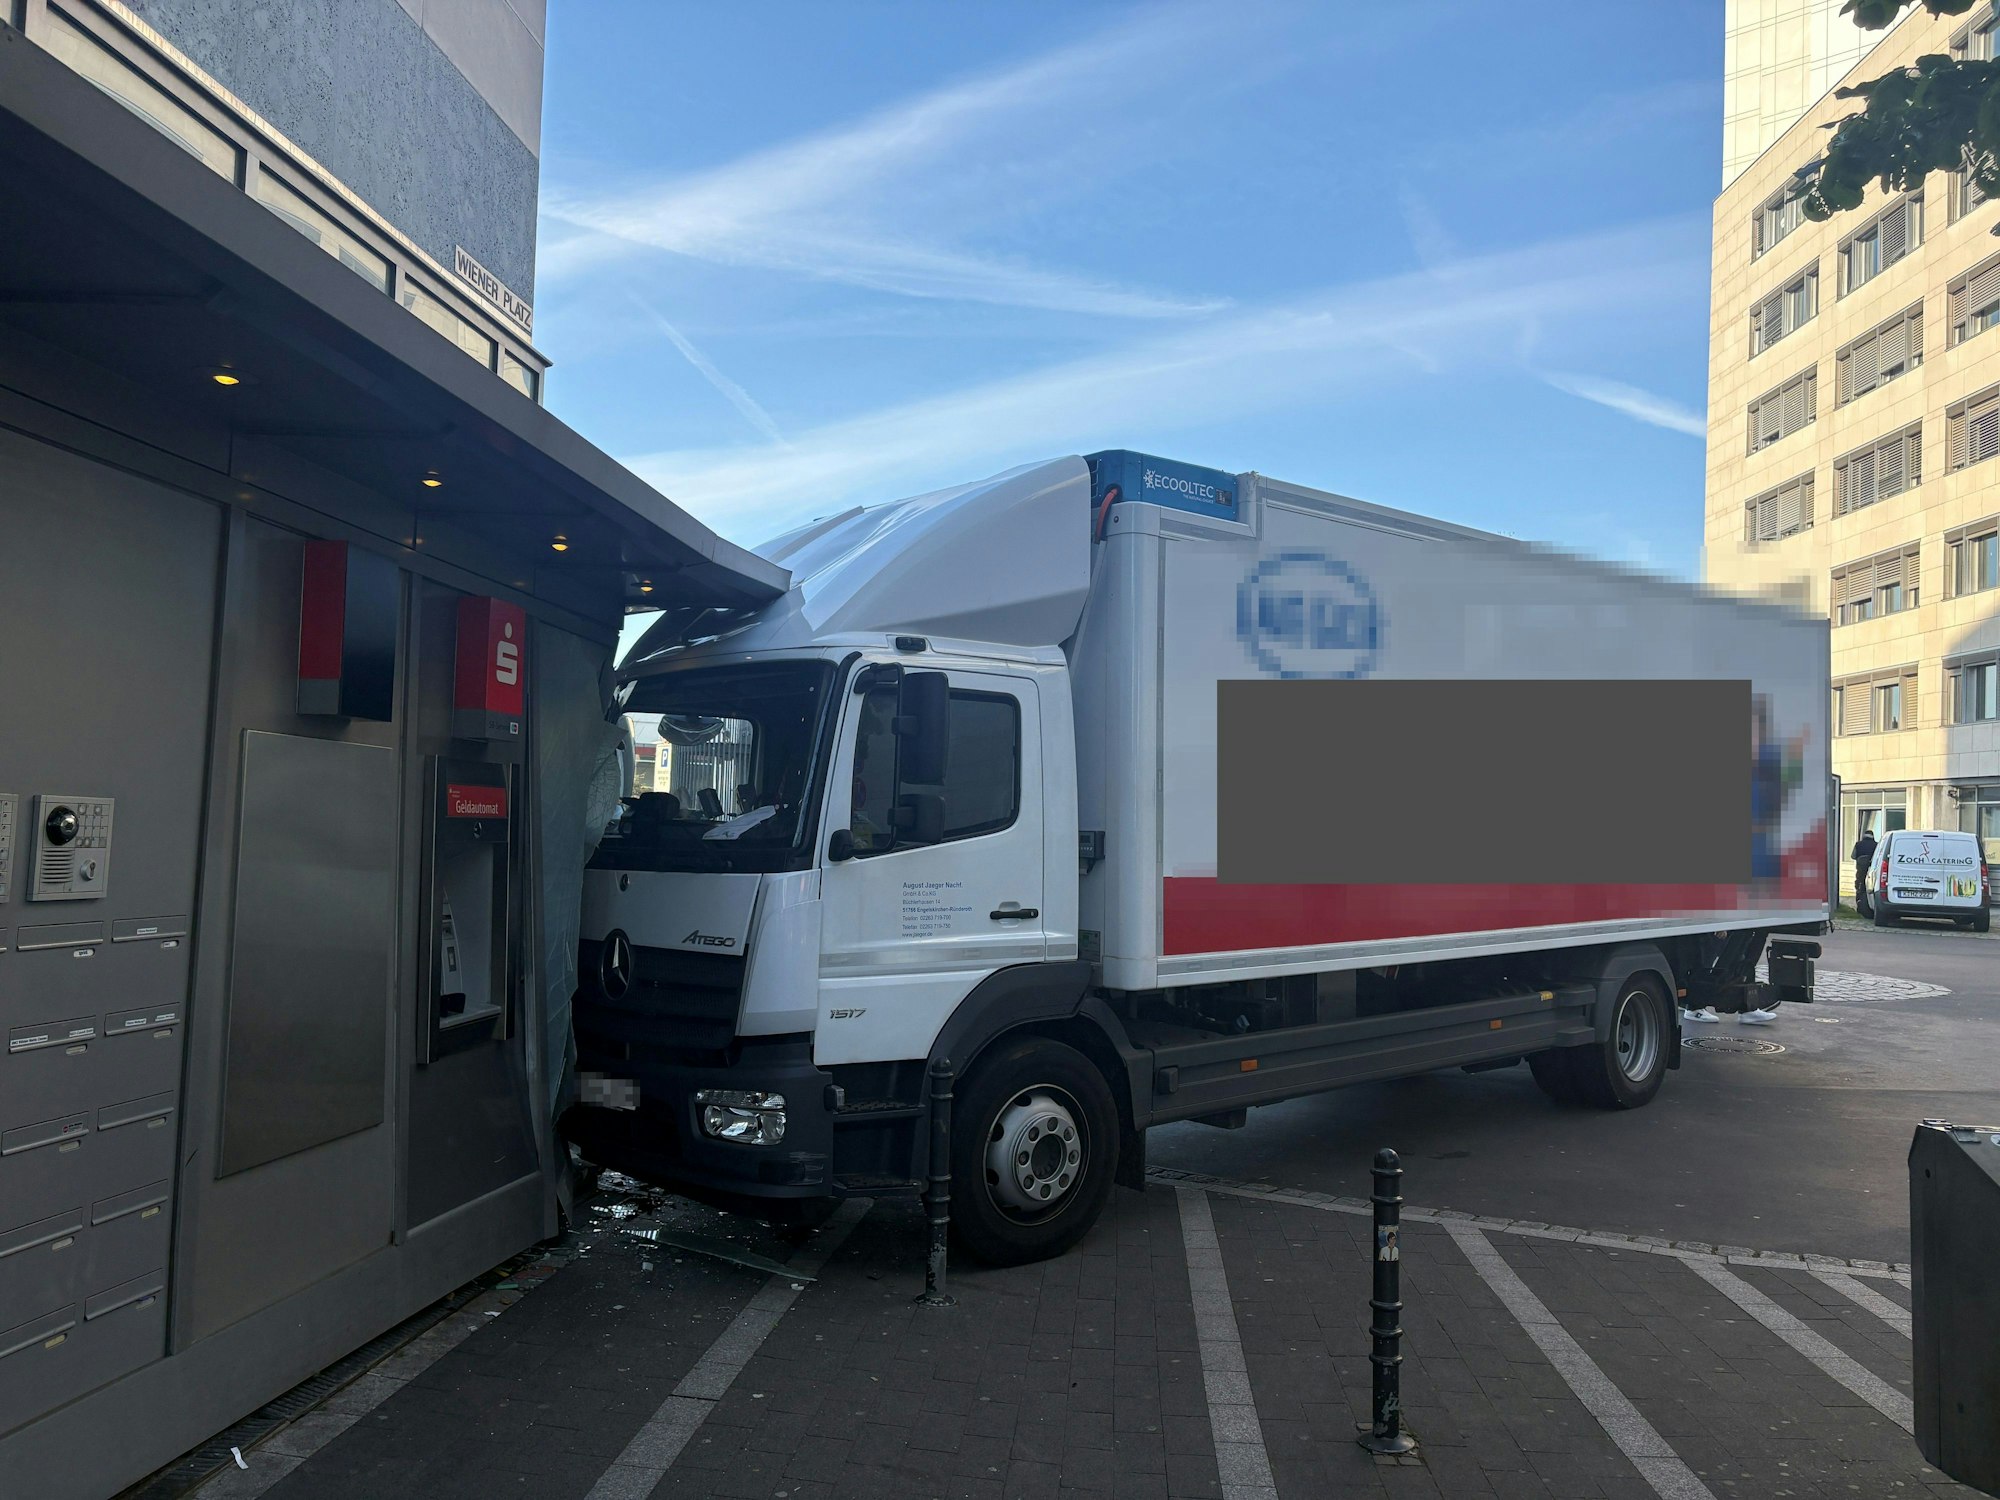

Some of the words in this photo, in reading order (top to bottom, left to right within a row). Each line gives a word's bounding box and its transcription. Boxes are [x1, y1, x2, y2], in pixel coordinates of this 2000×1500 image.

[457, 251, 499, 301] WIENER
[503, 290, 531, 328] PLATZ
[1154, 474, 1214, 498] ECOOLTEC
[455, 799, 499, 815] Geldautomat
[1897, 854, 1925, 864] ZOCH
[903, 882, 924, 890] August
[925, 882, 944, 890] Jaeger
[830, 1007, 866, 1019] 1517
